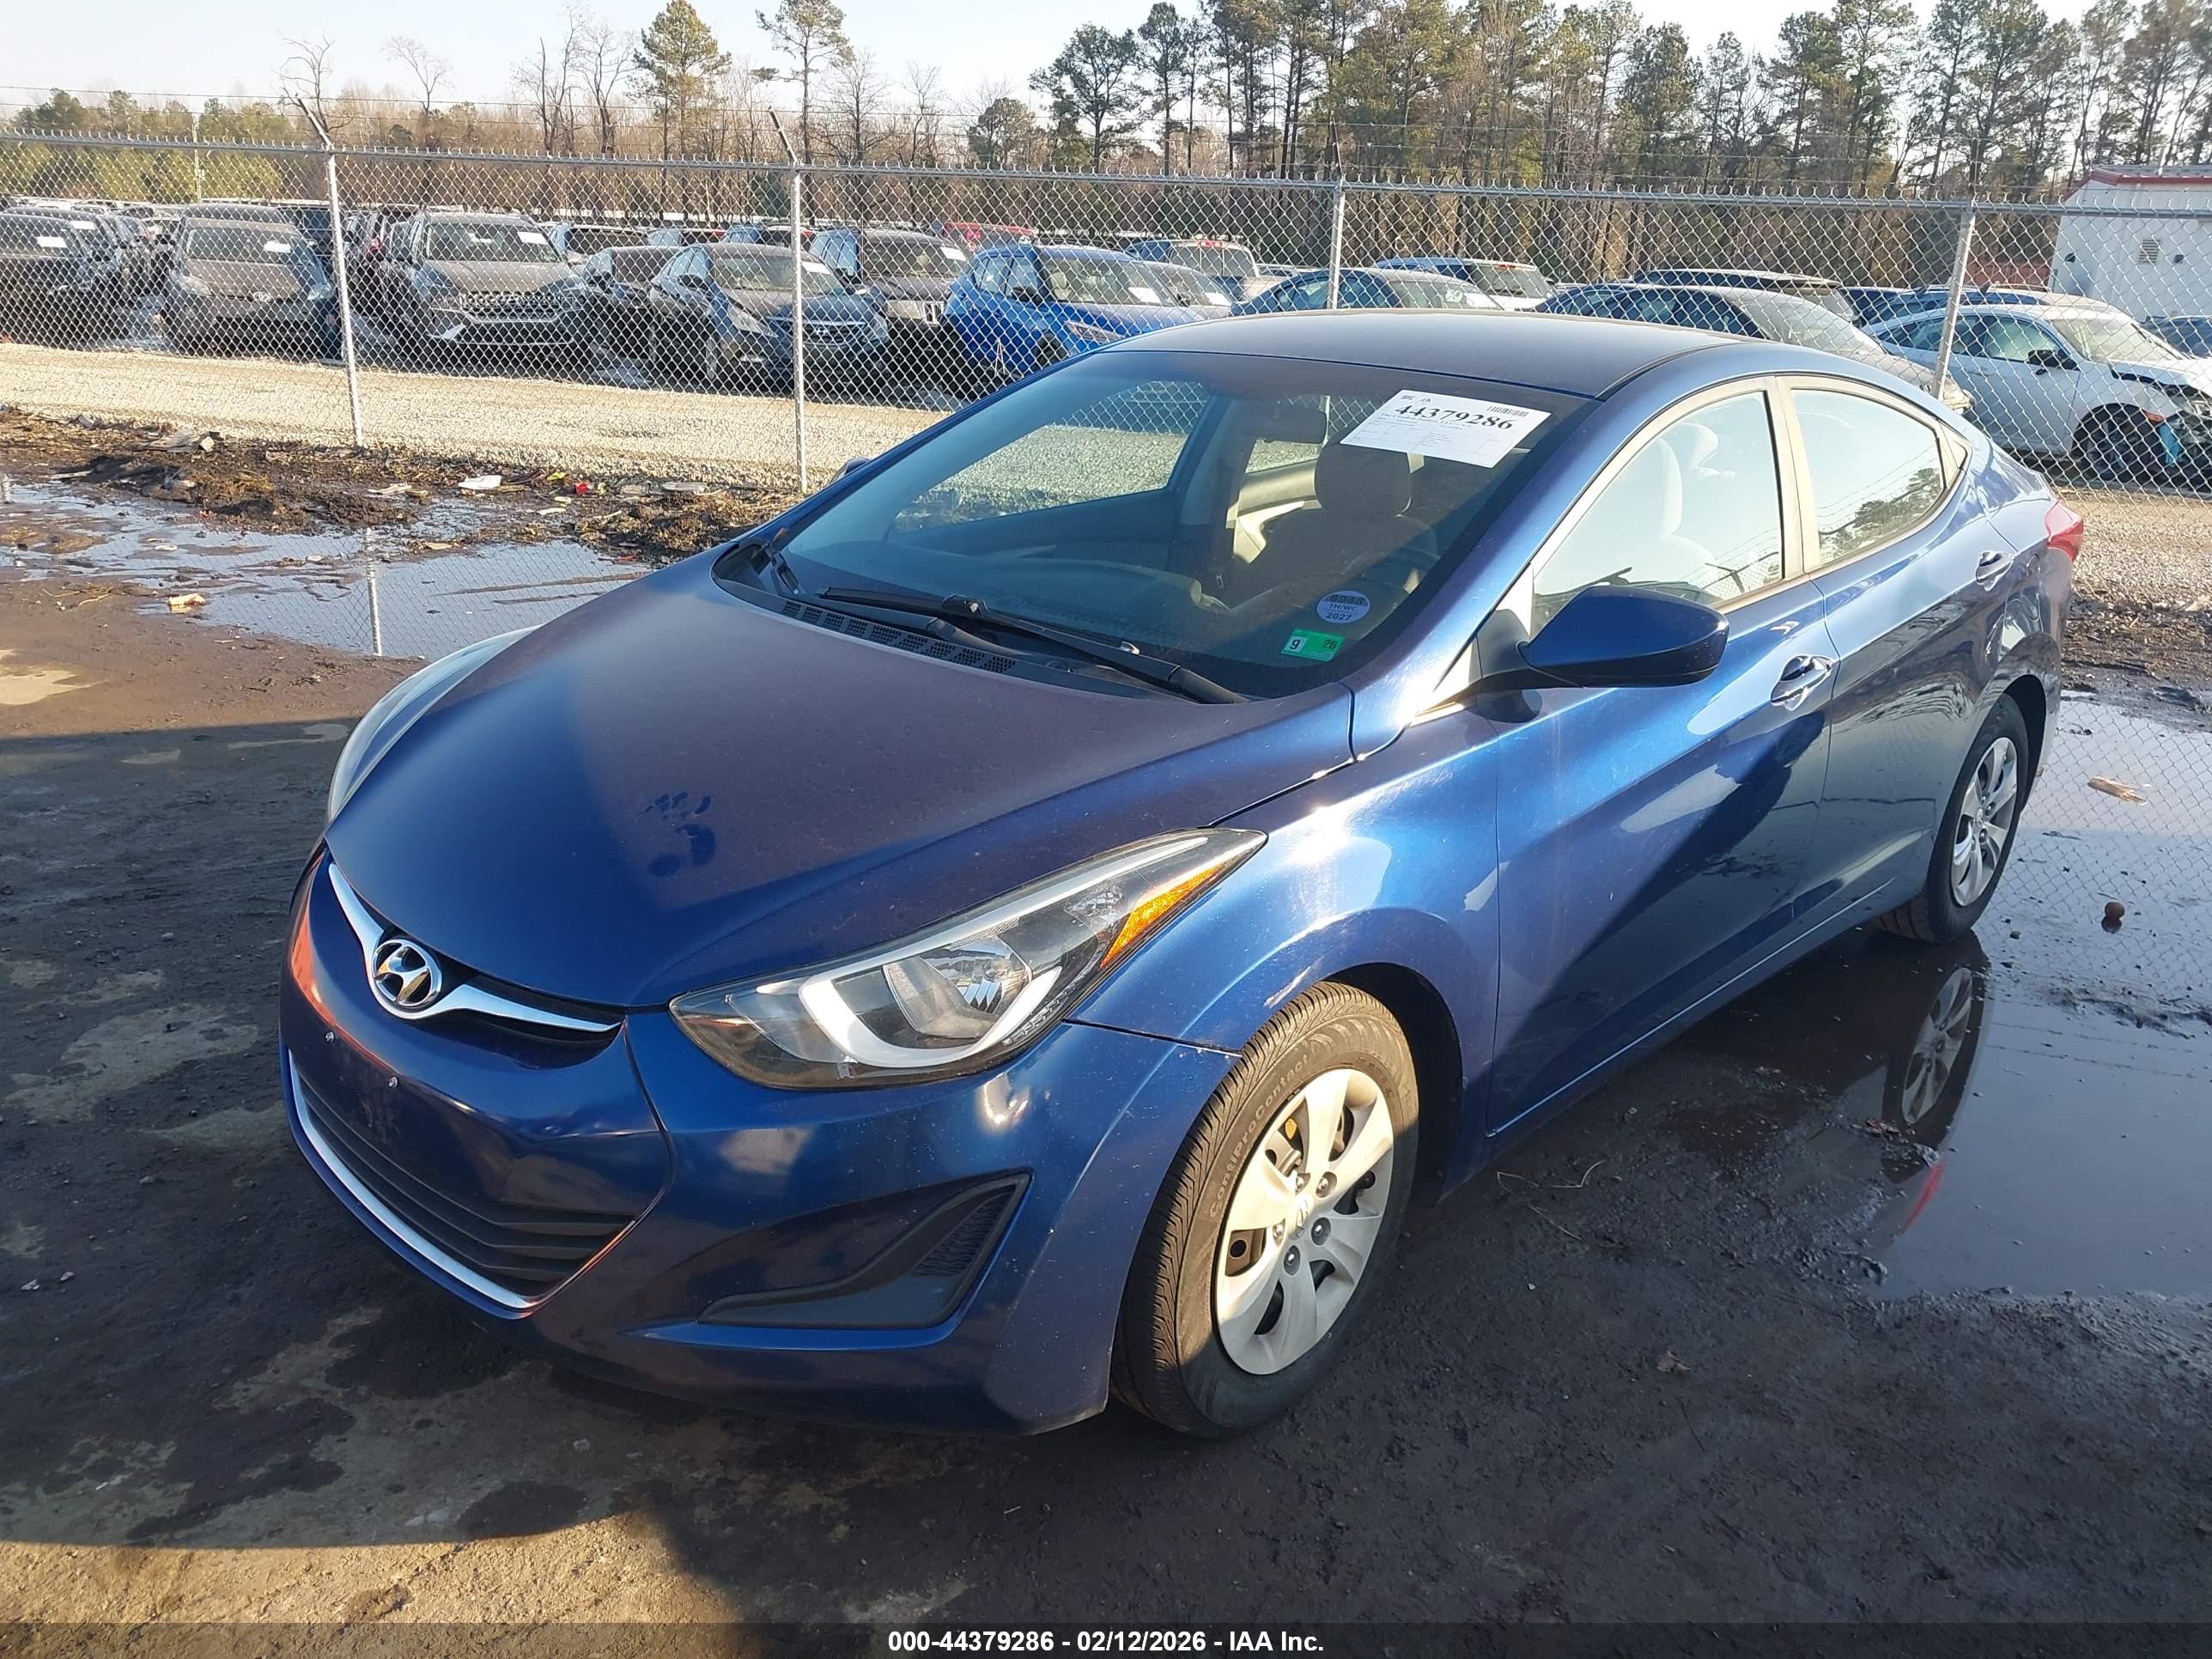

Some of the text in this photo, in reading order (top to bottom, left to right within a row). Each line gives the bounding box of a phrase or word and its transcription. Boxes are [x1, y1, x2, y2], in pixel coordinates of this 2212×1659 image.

[1395, 404, 1514, 430] 44379286
[1326, 612, 1353, 621] 2027
[1290, 639, 1299, 650] 9
[1209, 1054, 1310, 1218] ContiProContact
